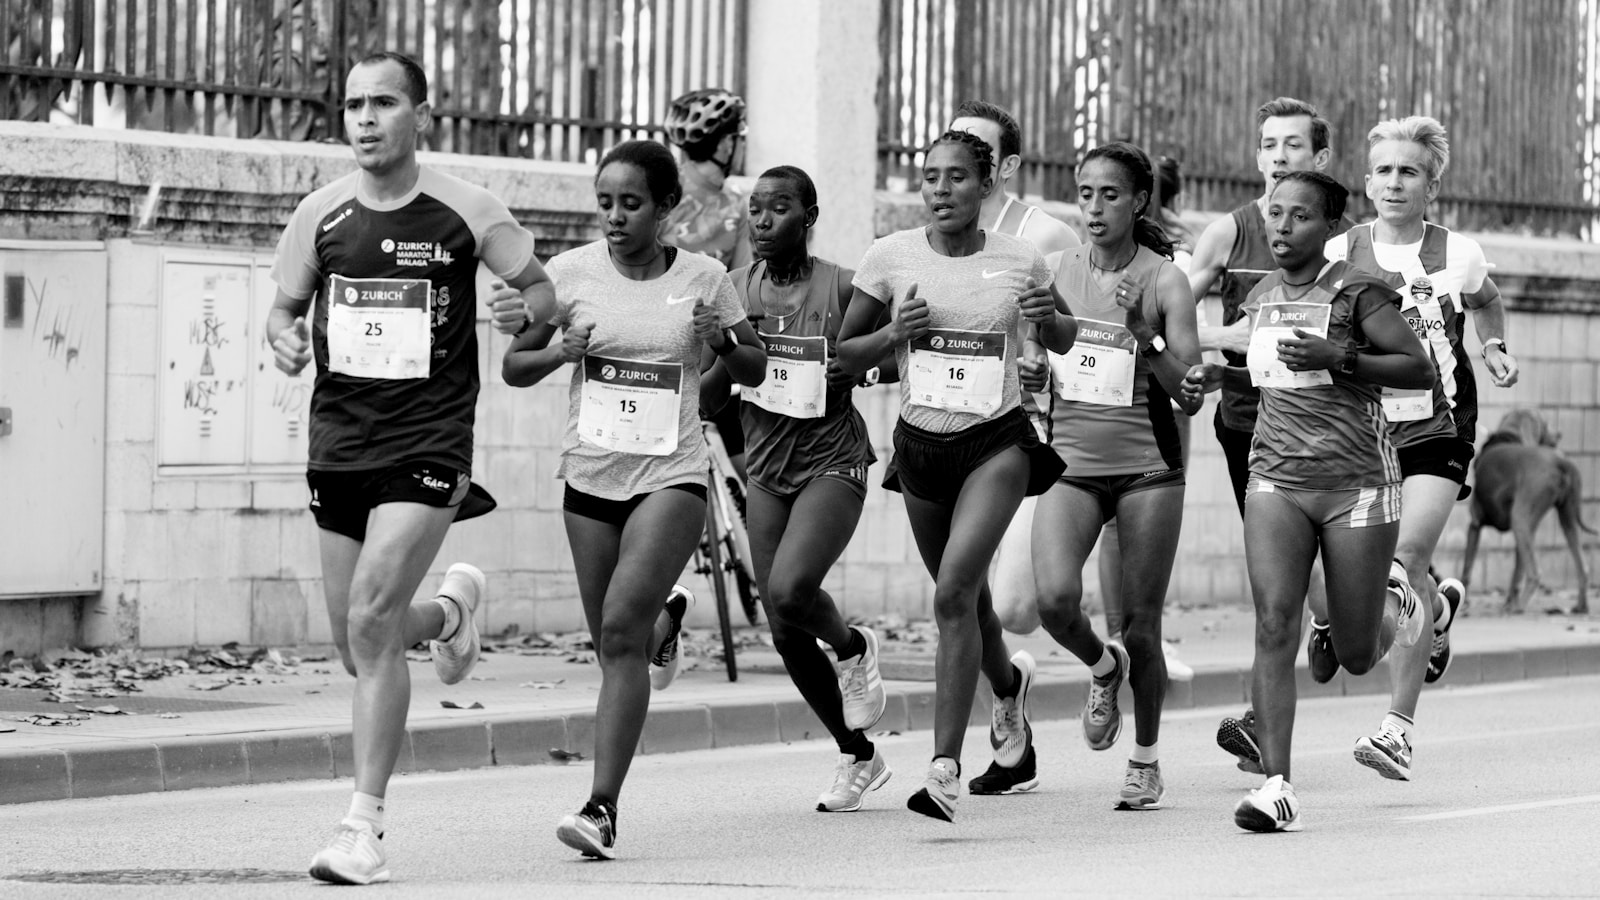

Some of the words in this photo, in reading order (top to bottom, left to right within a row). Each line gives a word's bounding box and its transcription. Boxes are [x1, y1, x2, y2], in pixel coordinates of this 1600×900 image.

[397, 242, 432, 250] ZURICH
[361, 290, 403, 301] ZURICH
[364, 322, 383, 336] 25
[1408, 317, 1443, 330] RTIVO
[1080, 328, 1115, 341] ZURICH
[768, 343, 804, 355] ZURICH
[947, 339, 984, 349] ZURICH
[1080, 354, 1096, 368] 20
[618, 369, 659, 382] ZURICH
[772, 368, 788, 381] 18
[948, 367, 965, 381] 16
[620, 399, 637, 413] 15
